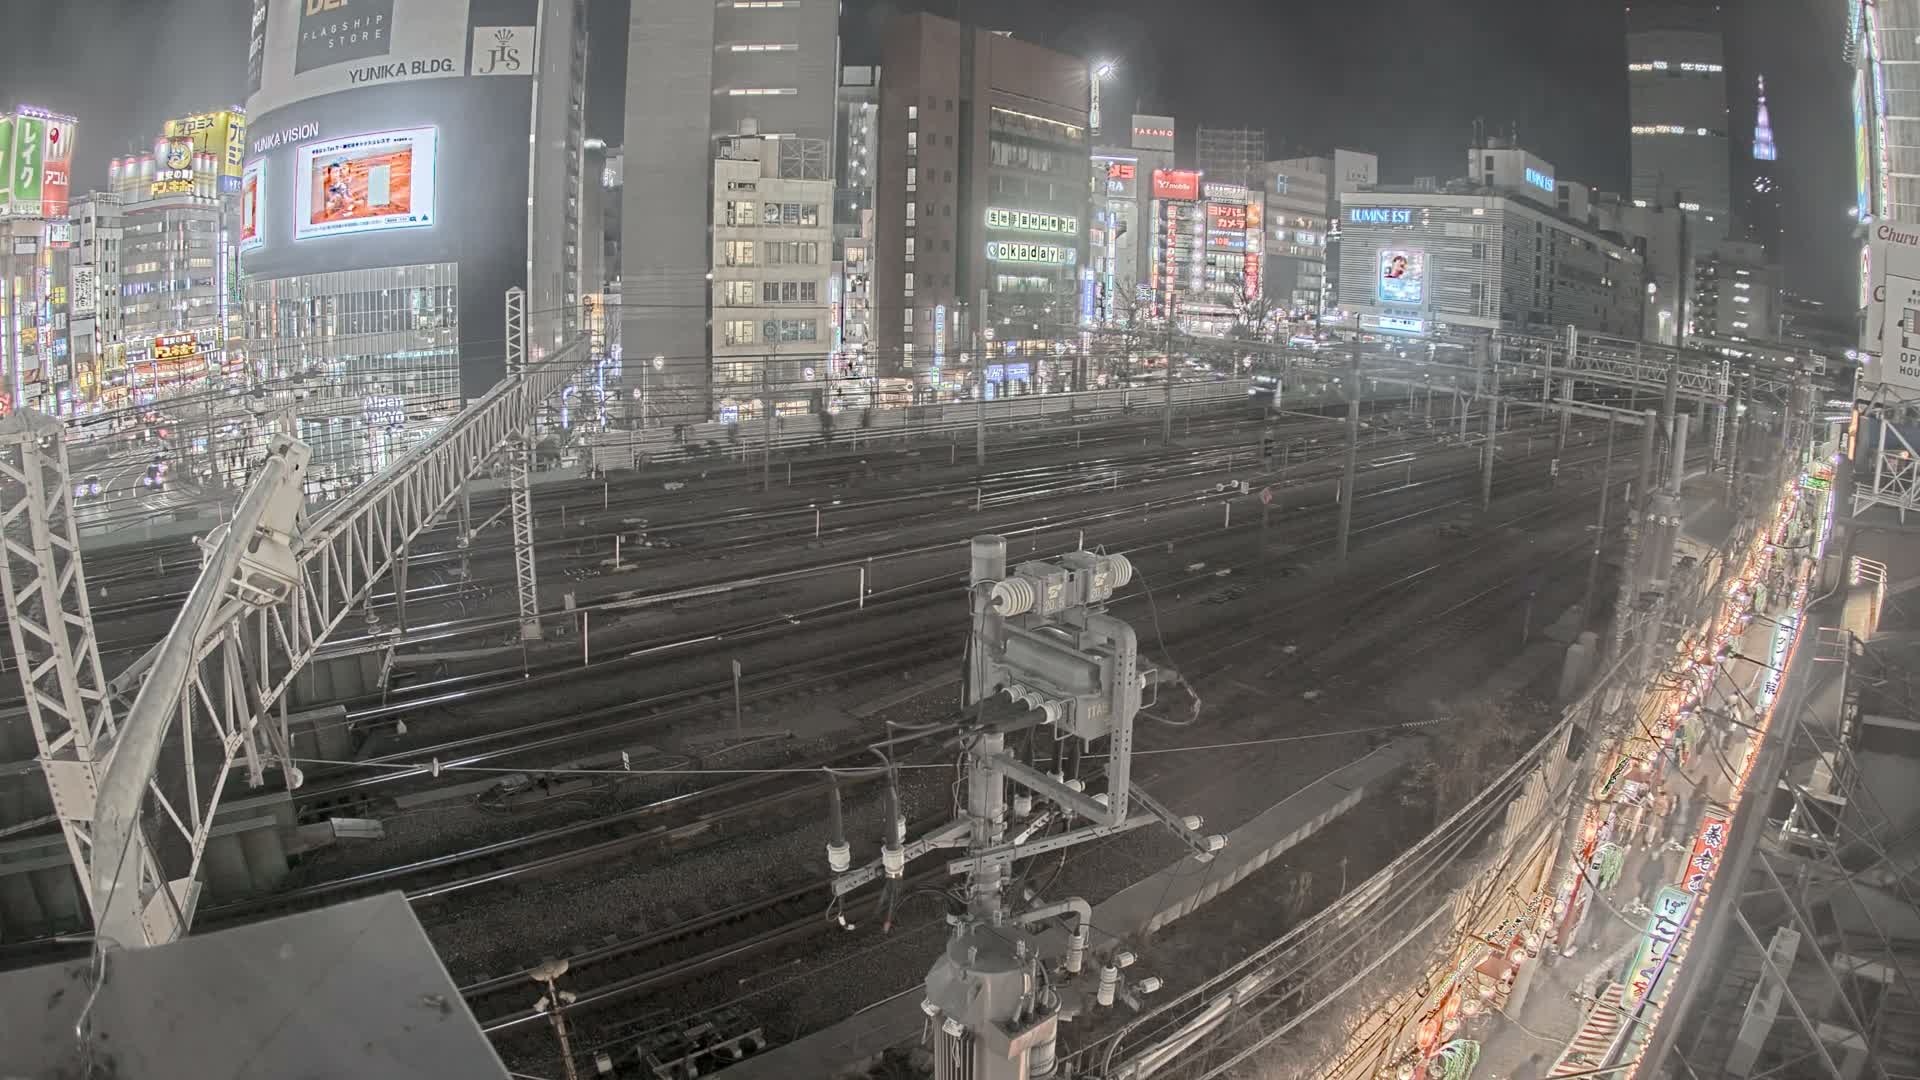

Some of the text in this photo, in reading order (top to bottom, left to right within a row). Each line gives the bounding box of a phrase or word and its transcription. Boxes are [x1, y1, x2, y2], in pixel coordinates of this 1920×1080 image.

[304, 15, 383, 40] FLAGSHIP
[328, 29, 382, 48] STORE
[349, 58, 456, 83] YUNIKA BLDG.
[254, 121, 319, 153] YUNIKA VISION
[1134, 127, 1174, 137] TAKANO
[20, 121, 37, 189] レイク
[45, 170, 68, 185] アコム
[1207, 205, 1246, 218] ヨドバシ
[1351, 207, 1411, 223] LUMINE EST
[1217, 218, 1246, 230] カメラ
[1877, 225, 1919, 246] Churu
[1000, 245, 1065, 260] okadaya
[1900, 352, 1920, 365] OP
[364, 396, 403, 409] Alpen
